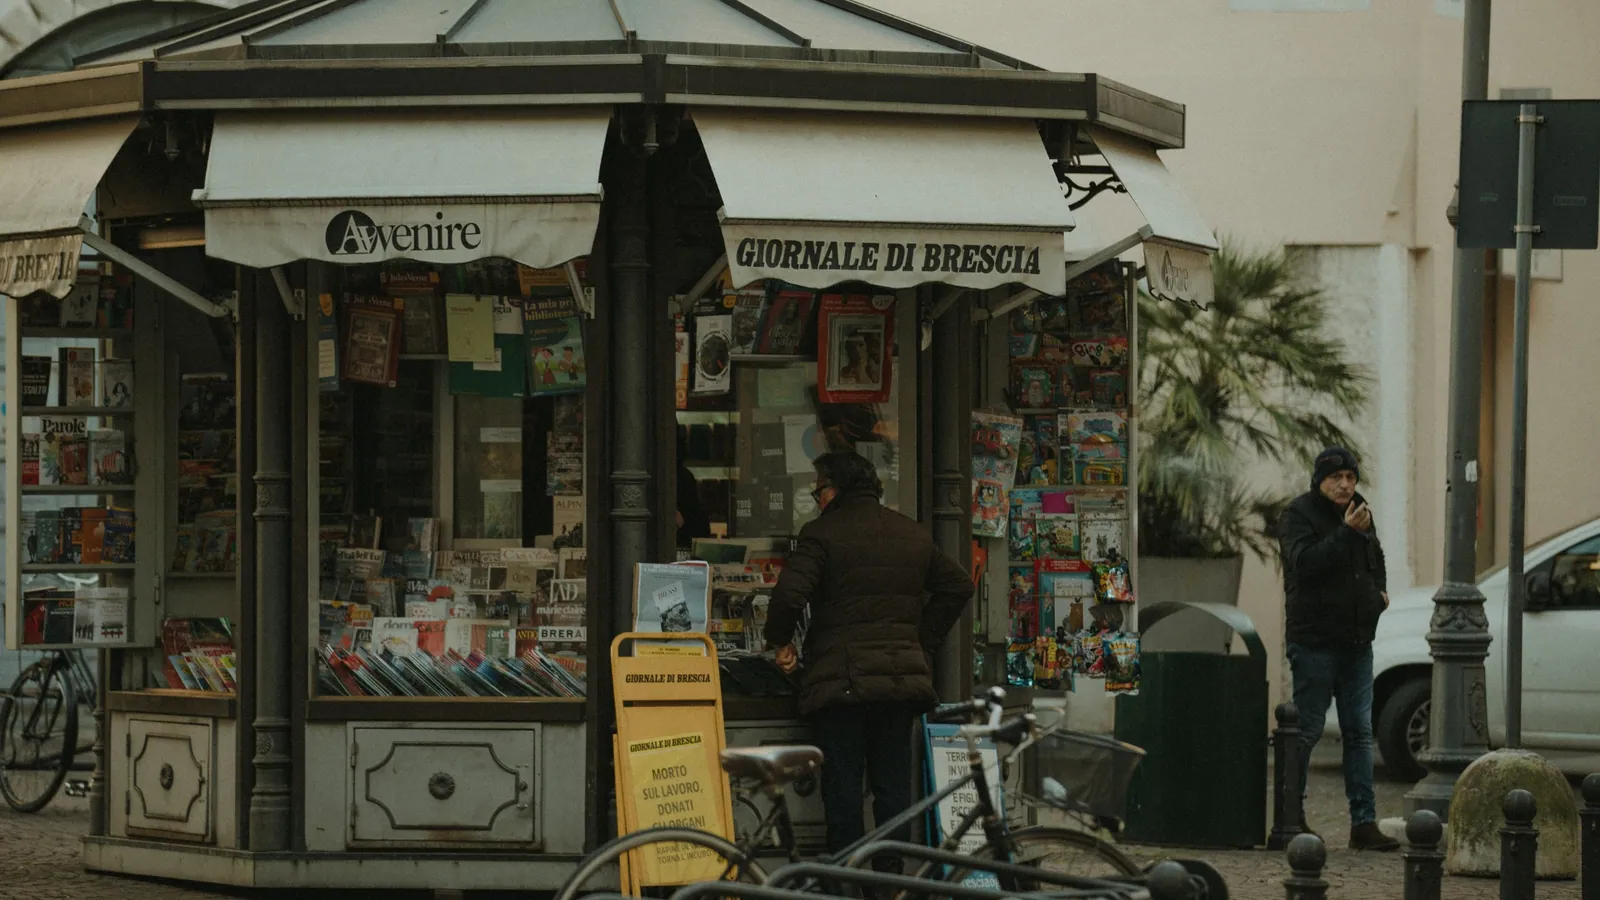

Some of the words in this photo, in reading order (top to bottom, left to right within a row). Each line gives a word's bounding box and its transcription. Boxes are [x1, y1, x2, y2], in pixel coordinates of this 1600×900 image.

[736, 238, 879, 271] GIORNALE
[884, 243, 916, 272] DI
[922, 243, 1040, 274] BRESCIA
[42, 418, 86, 433] Parole
[384, 620, 414, 629] dom
[541, 629, 583, 639] BRERA
[717, 641, 737, 650] orbes
[626, 674, 665, 684] GIORNALE
[667, 674, 676, 683] DI
[677, 673, 710, 683] BRESCIA
[630, 740, 663, 753] GIORNALE
[664, 738, 671, 748] DI
[672, 735, 702, 747] BRESCIA
[652, 765, 687, 780] MORTO
[643, 786, 660, 800] SUL
[661, 781, 703, 797] LAVORO,
[657, 800, 694, 816] DONATI
[666, 816, 706, 829] ORGANI
[657, 854, 680, 865] TORNA
